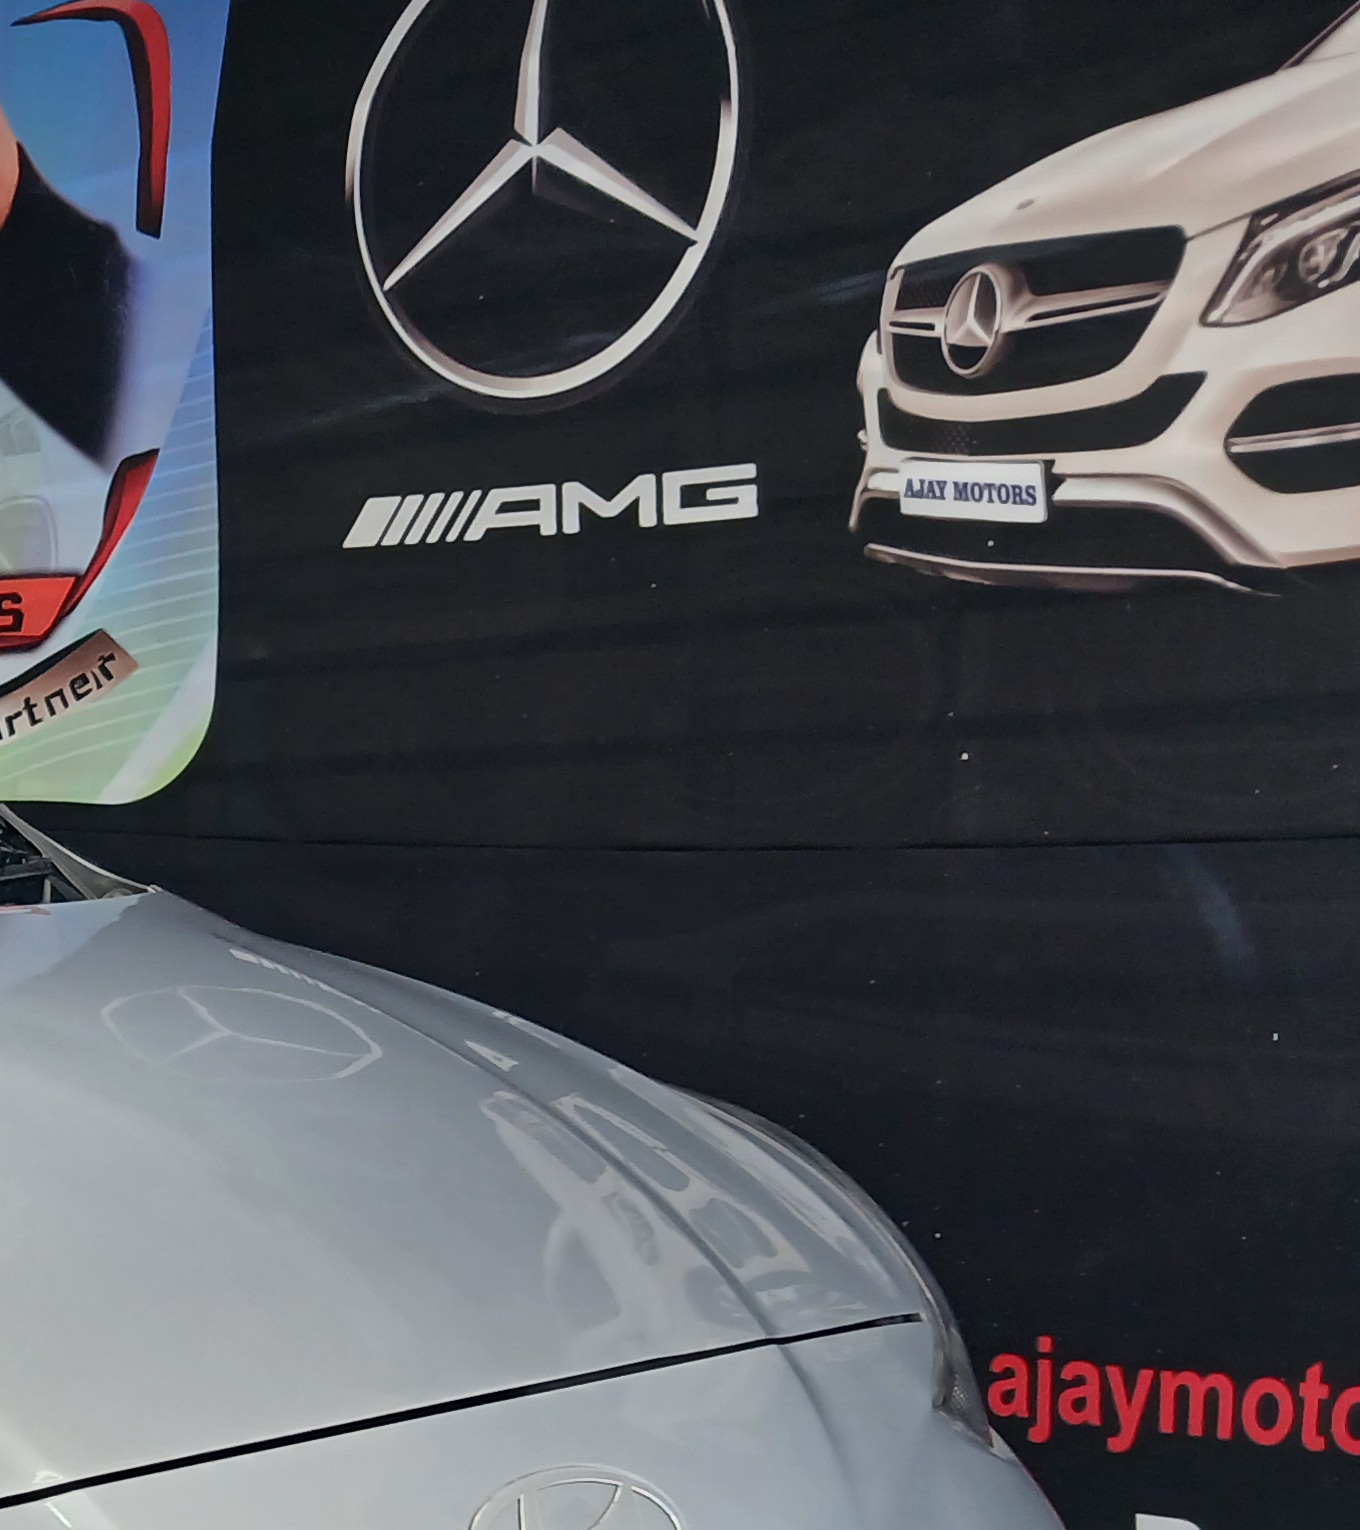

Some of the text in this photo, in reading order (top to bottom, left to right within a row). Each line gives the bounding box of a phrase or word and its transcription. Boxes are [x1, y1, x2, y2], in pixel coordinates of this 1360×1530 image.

[903, 478, 1038, 506] AJAY MOTORS
[987, 1335, 1360, 1456] ajaymoto
